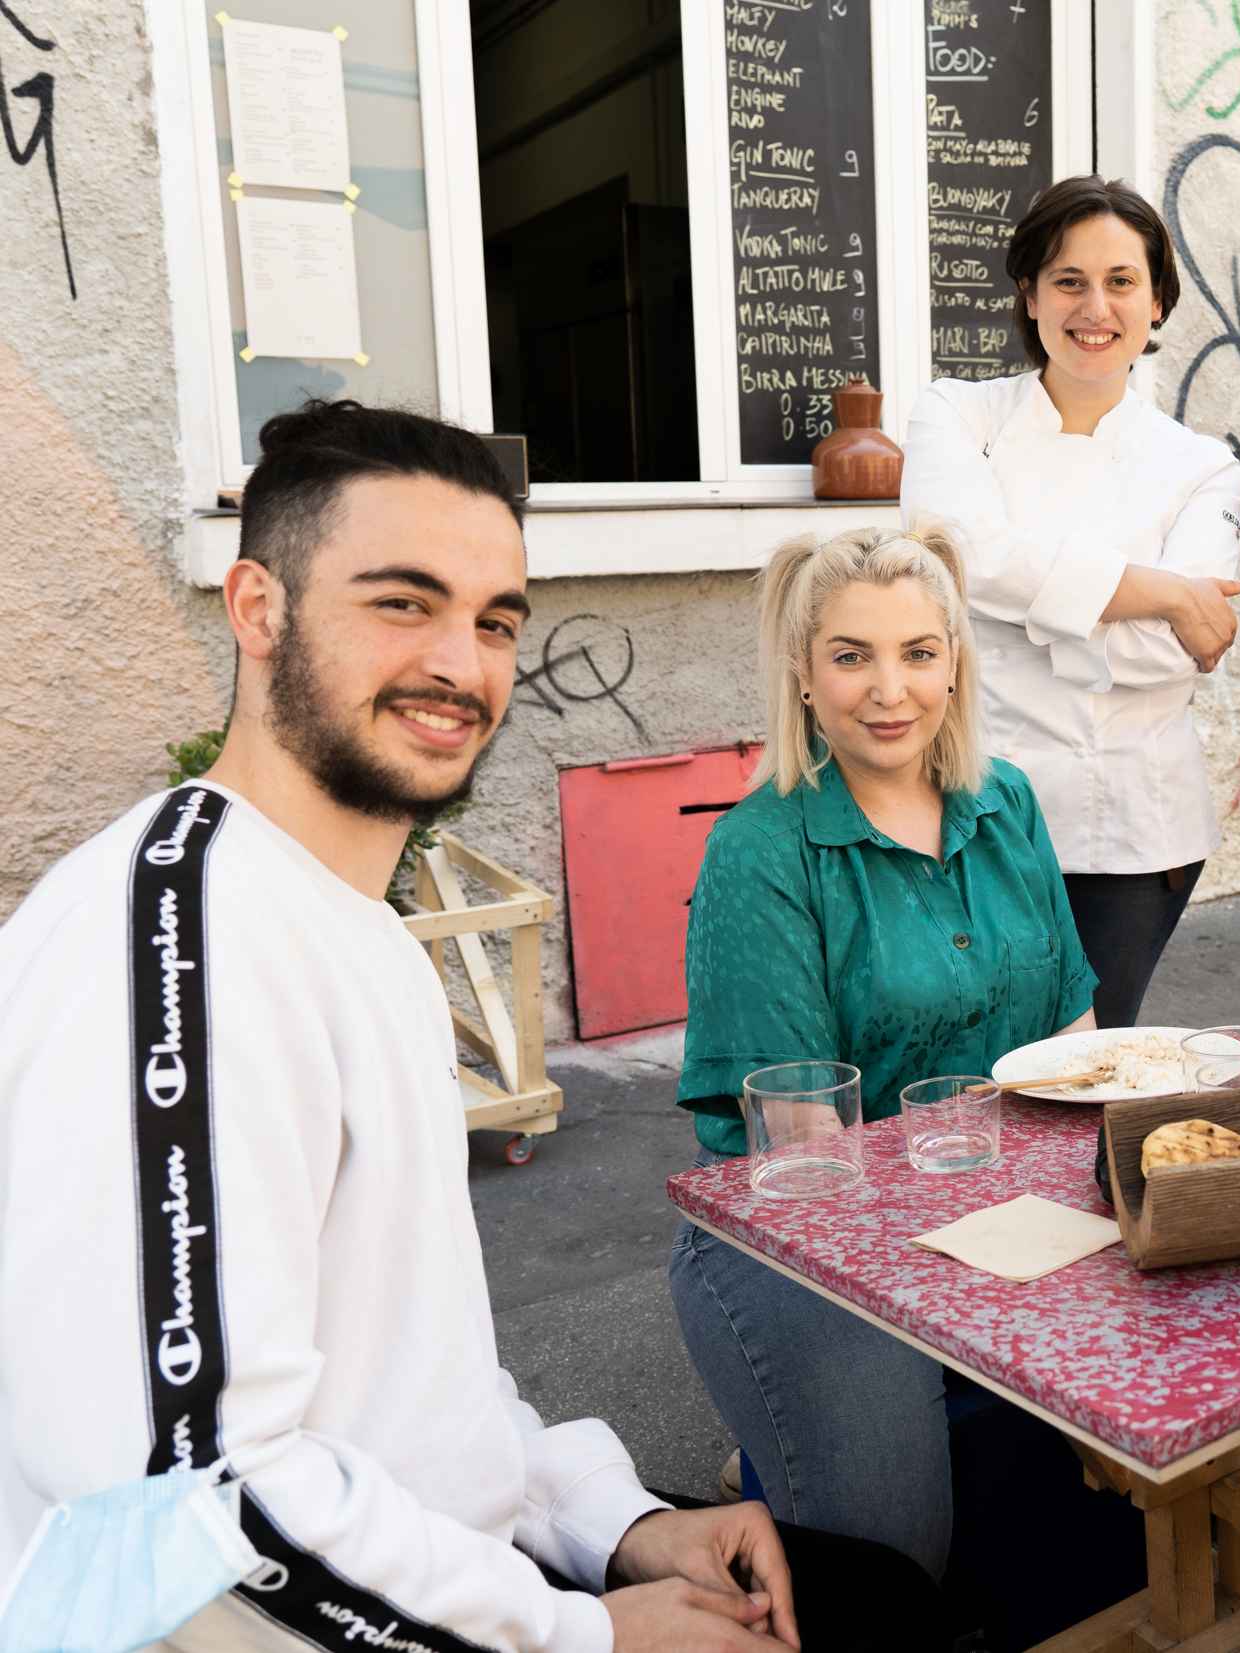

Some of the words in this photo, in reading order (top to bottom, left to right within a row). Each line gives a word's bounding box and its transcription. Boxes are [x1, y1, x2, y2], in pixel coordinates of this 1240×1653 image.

[726, 5, 776, 32] MALFY
[926, 24, 997, 74] FOOD:
[728, 59, 804, 88] ELEPHANT
[730, 85, 786, 112] ENGINE
[1023, 97, 1040, 127] 6
[730, 139, 764, 182] GIN
[766, 142, 815, 172] TONIC
[839, 150, 860, 177] 9
[731, 182, 820, 215] TANQUERAY
[735, 225, 782, 259] VODKA
[780, 226, 829, 256] TONIC
[842, 233, 863, 258] 9
[737, 264, 804, 295] ALTATTO
[807, 266, 849, 293] MULE
[930, 252, 989, 280] RISOTTO
[740, 301, 831, 333] MARGARITA
[737, 330, 834, 358] CAIPIRINHA
[740, 363, 798, 394] BIRRA
[145, 788, 211, 866] Champion
[145, 887, 196, 1109] Champion
[158, 1143, 207, 1386] Champion
